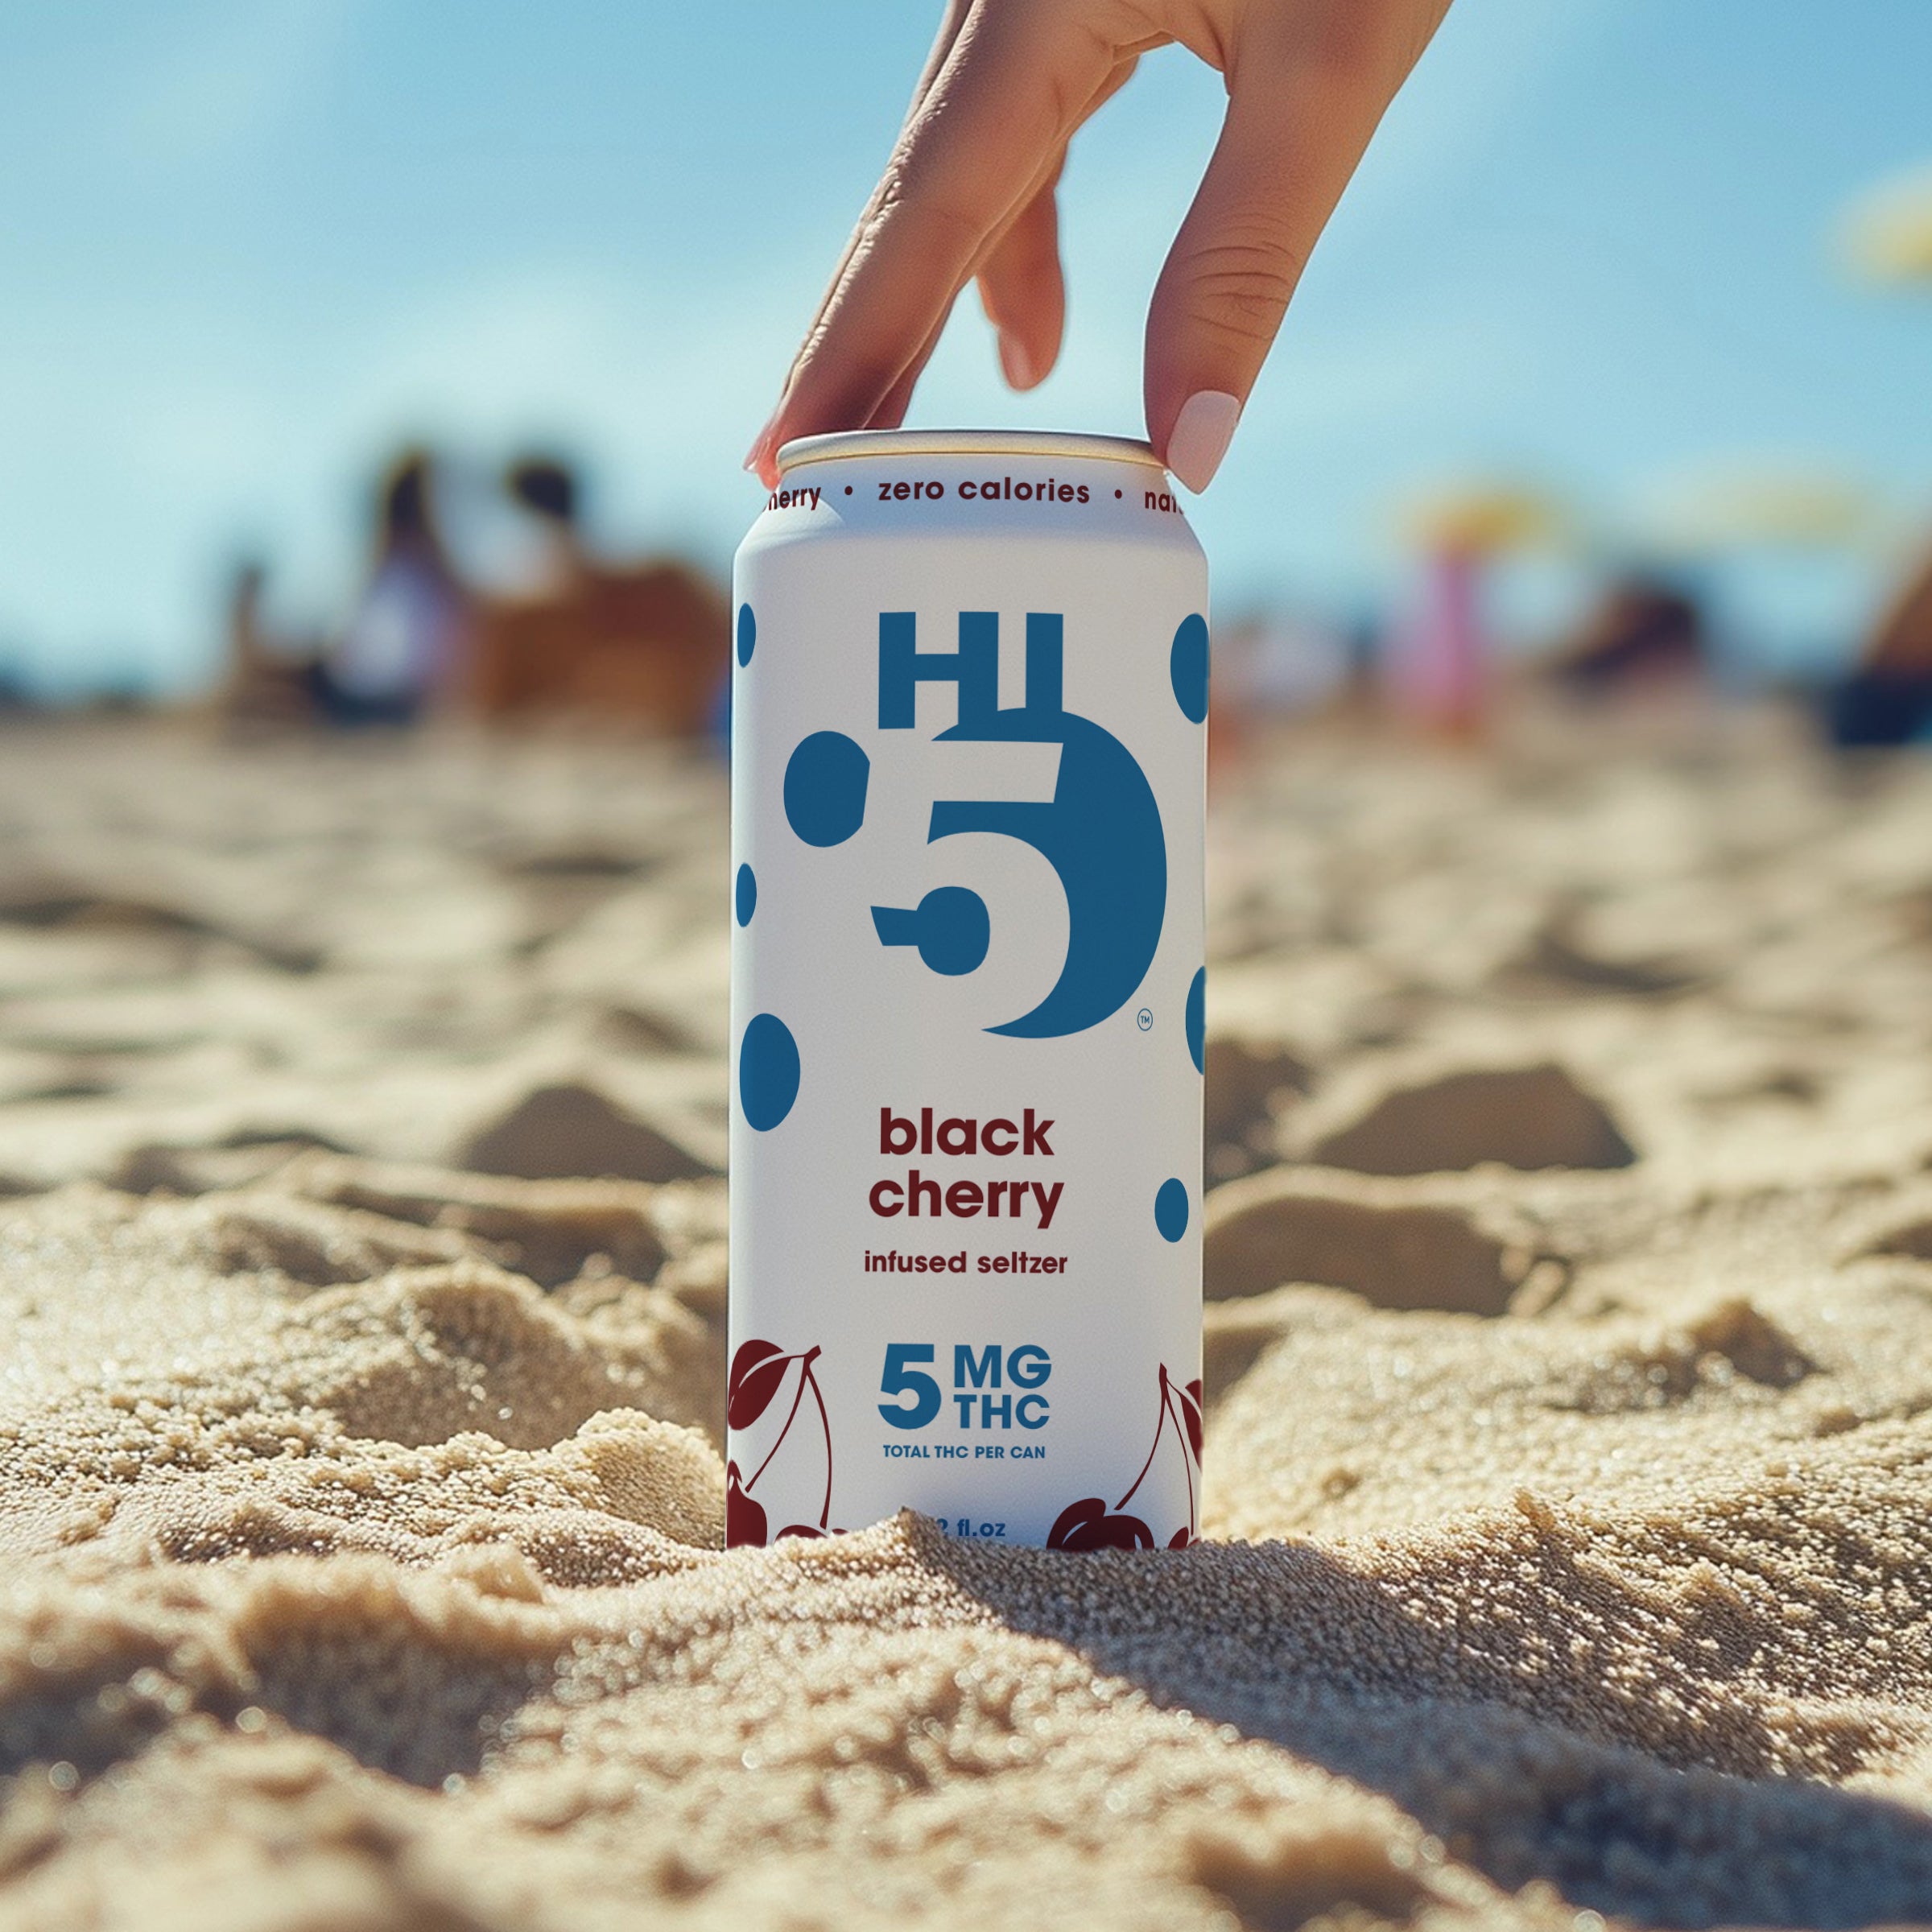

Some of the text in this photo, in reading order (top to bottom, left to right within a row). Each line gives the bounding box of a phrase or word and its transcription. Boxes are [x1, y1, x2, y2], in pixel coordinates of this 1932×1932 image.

[762, 477, 1184, 515] herry zero calories nat
[878, 611, 1063, 729] HI
[863, 739, 1071, 1034] 5
[881, 1108, 1055, 1155] black
[869, 1170, 1064, 1228] cherry
[865, 1251, 1067, 1274] infused seltzer
[878, 1344, 1051, 1430] 5 MG
[954, 1394, 1049, 1429] THC
[883, 1445, 1045, 1458] TOTAL THC PER CAN
[956, 1517, 1006, 1538] fl.oz
